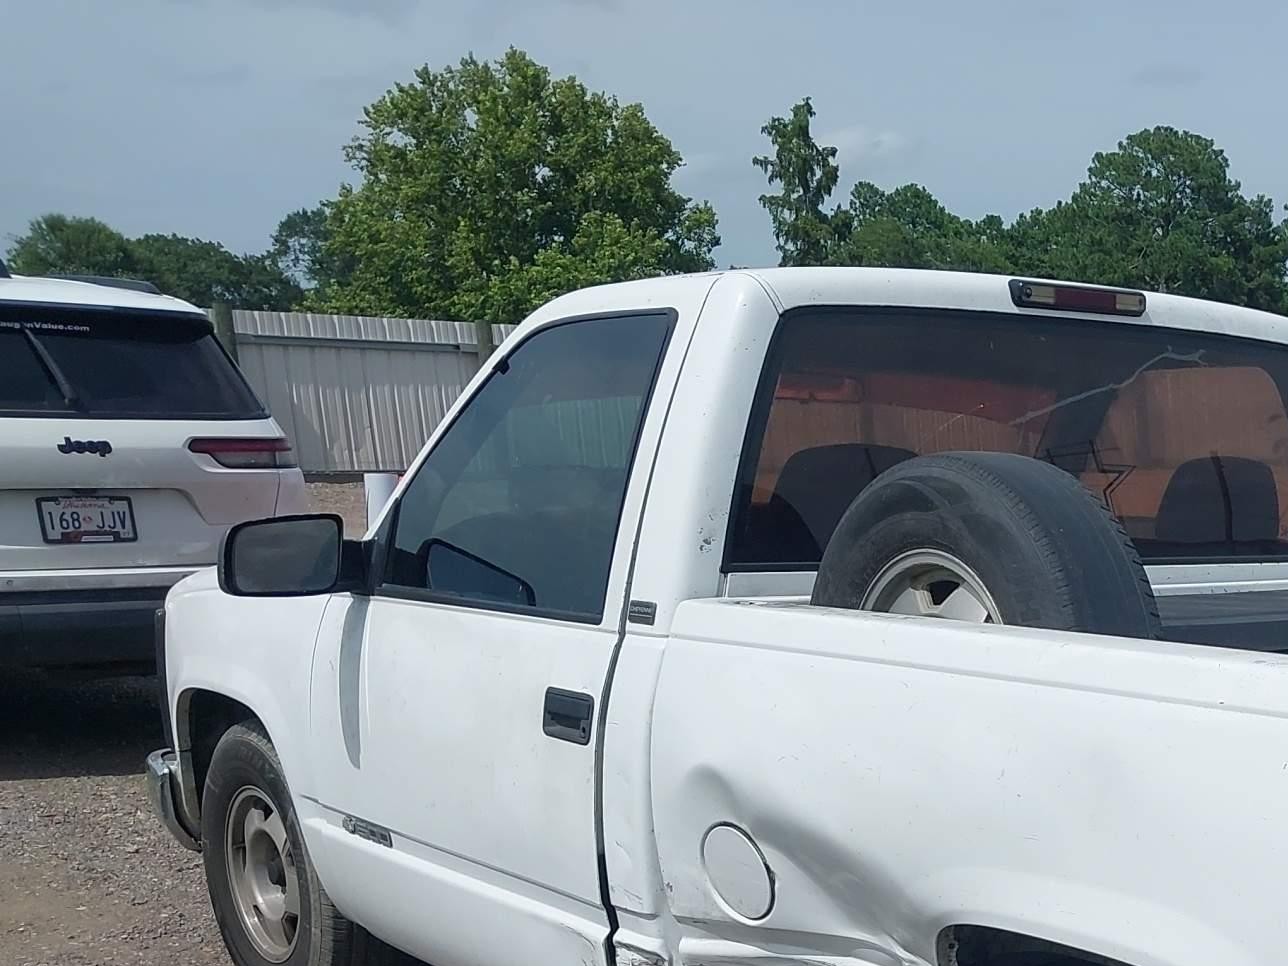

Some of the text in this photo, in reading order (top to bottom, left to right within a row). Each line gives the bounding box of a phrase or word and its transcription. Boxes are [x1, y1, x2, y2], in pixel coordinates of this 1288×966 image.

[57, 437, 113, 458] Jeep
[48, 511, 126, 530] 168 JJV
